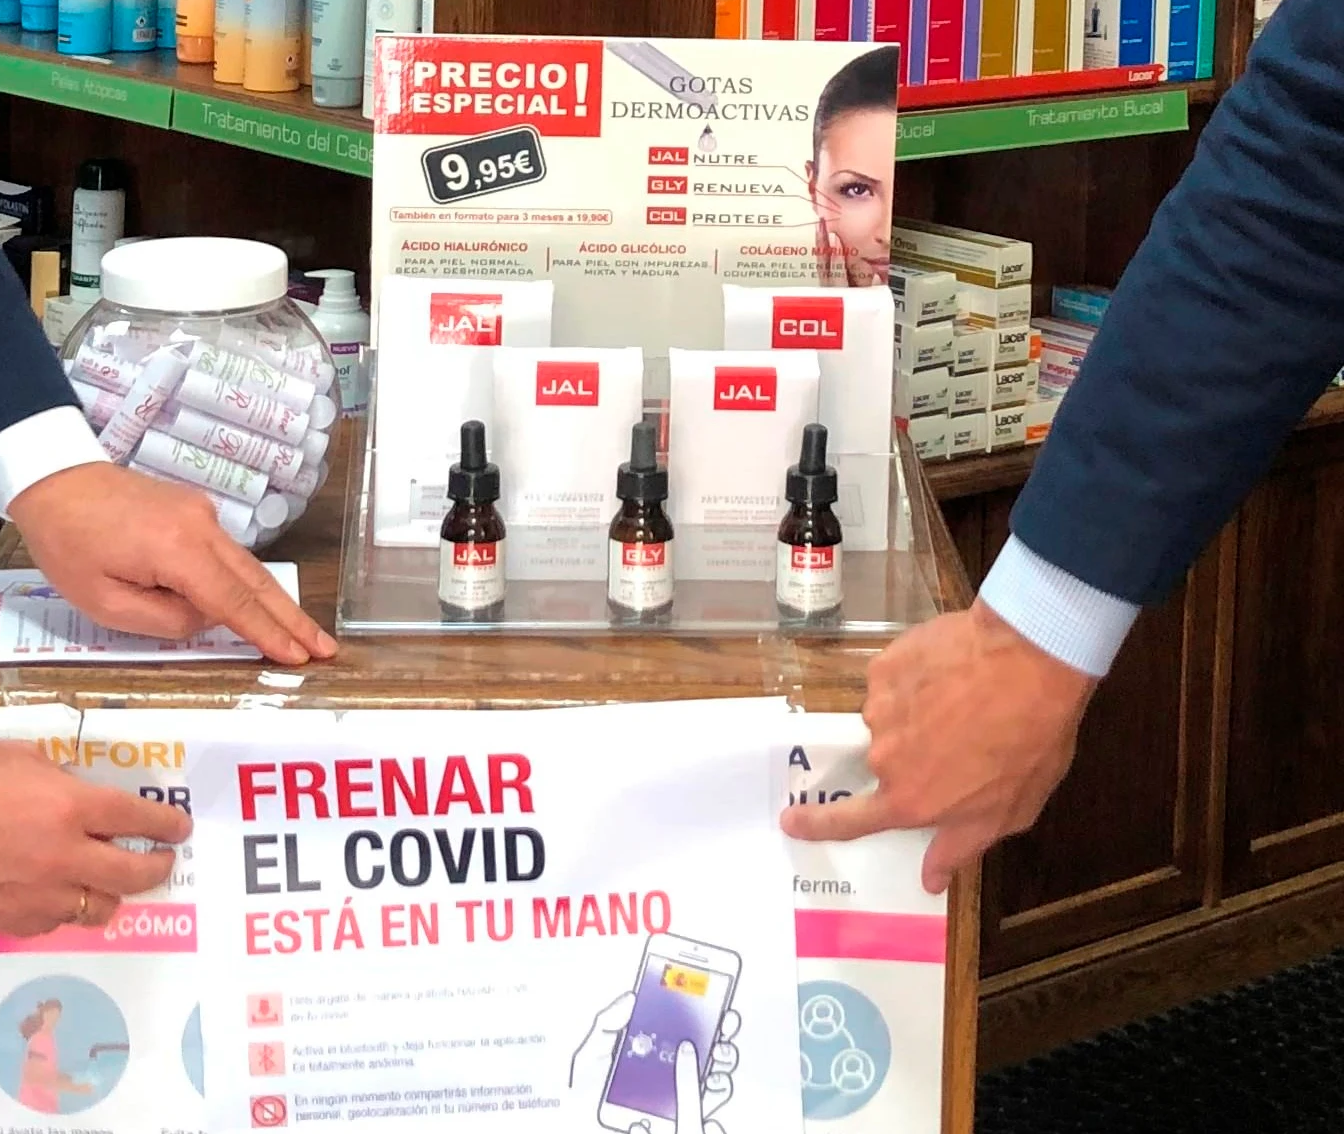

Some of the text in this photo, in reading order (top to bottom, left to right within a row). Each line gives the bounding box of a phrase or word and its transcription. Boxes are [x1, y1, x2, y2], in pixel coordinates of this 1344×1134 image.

[1128, 70, 1155, 82] Lacer
[669, 76, 753, 95] GOTAS
[611, 101, 809, 122] DERMOACTIVAS
[1026, 98, 1164, 127] Tratamiento Bucal
[201, 102, 330, 153] Tratamiento del
[651, 150, 758, 164] JAL NUTRE
[439, 149, 535, 192] 9,95€
[650, 180, 785, 194] GLY RENUEVA
[392, 210, 435, 220] También
[454, 211, 494, 221] formato
[497, 213, 520, 224] para
[522, 213, 529, 221] 3
[576, 213, 609, 223] 19,90€
[649, 211, 783, 224] COL PROTEGE
[401, 239, 528, 252] ÁCIDO HIALURÓNICO
[579, 242, 687, 254] ÁCIDO GLICÓLICO
[740, 243, 808, 256] COLÁGENO
[440, 258, 464, 266] PIEL
[737, 261, 766, 269] PARA
[1001, 263, 1024, 274] Lacer
[443, 268, 534, 276] DESHIDRATADA
[438, 313, 497, 335] JAL
[779, 317, 837, 337] COL
[999, 331, 1027, 345] Lacer
[332, 344, 359, 353] NUEVO
[996, 371, 1025, 385] Lacer
[542, 378, 593, 396] JAL
[719, 382, 771, 400] JAL
[995, 412, 1024, 427] Lacer
[456, 548, 494, 562] JAL
[624, 548, 663, 562] GLY
[793, 552, 832, 565] COL
[236, 752, 536, 821] FRENAR
[243, 826, 546, 895] EL COVID
[104, 909, 193, 940] ¿CÓMO
[245, 889, 673, 956] ESTÁ EN TU MANO
[294, 1083, 532, 1108] En ningún momento compartirás información
[348, 1104, 428, 1121] geolocalización
[444, 1104, 455, 1114] tu
[457, 1098, 498, 1114] número
[502, 1098, 515, 1110] de
[518, 1096, 561, 1110] teléfono
